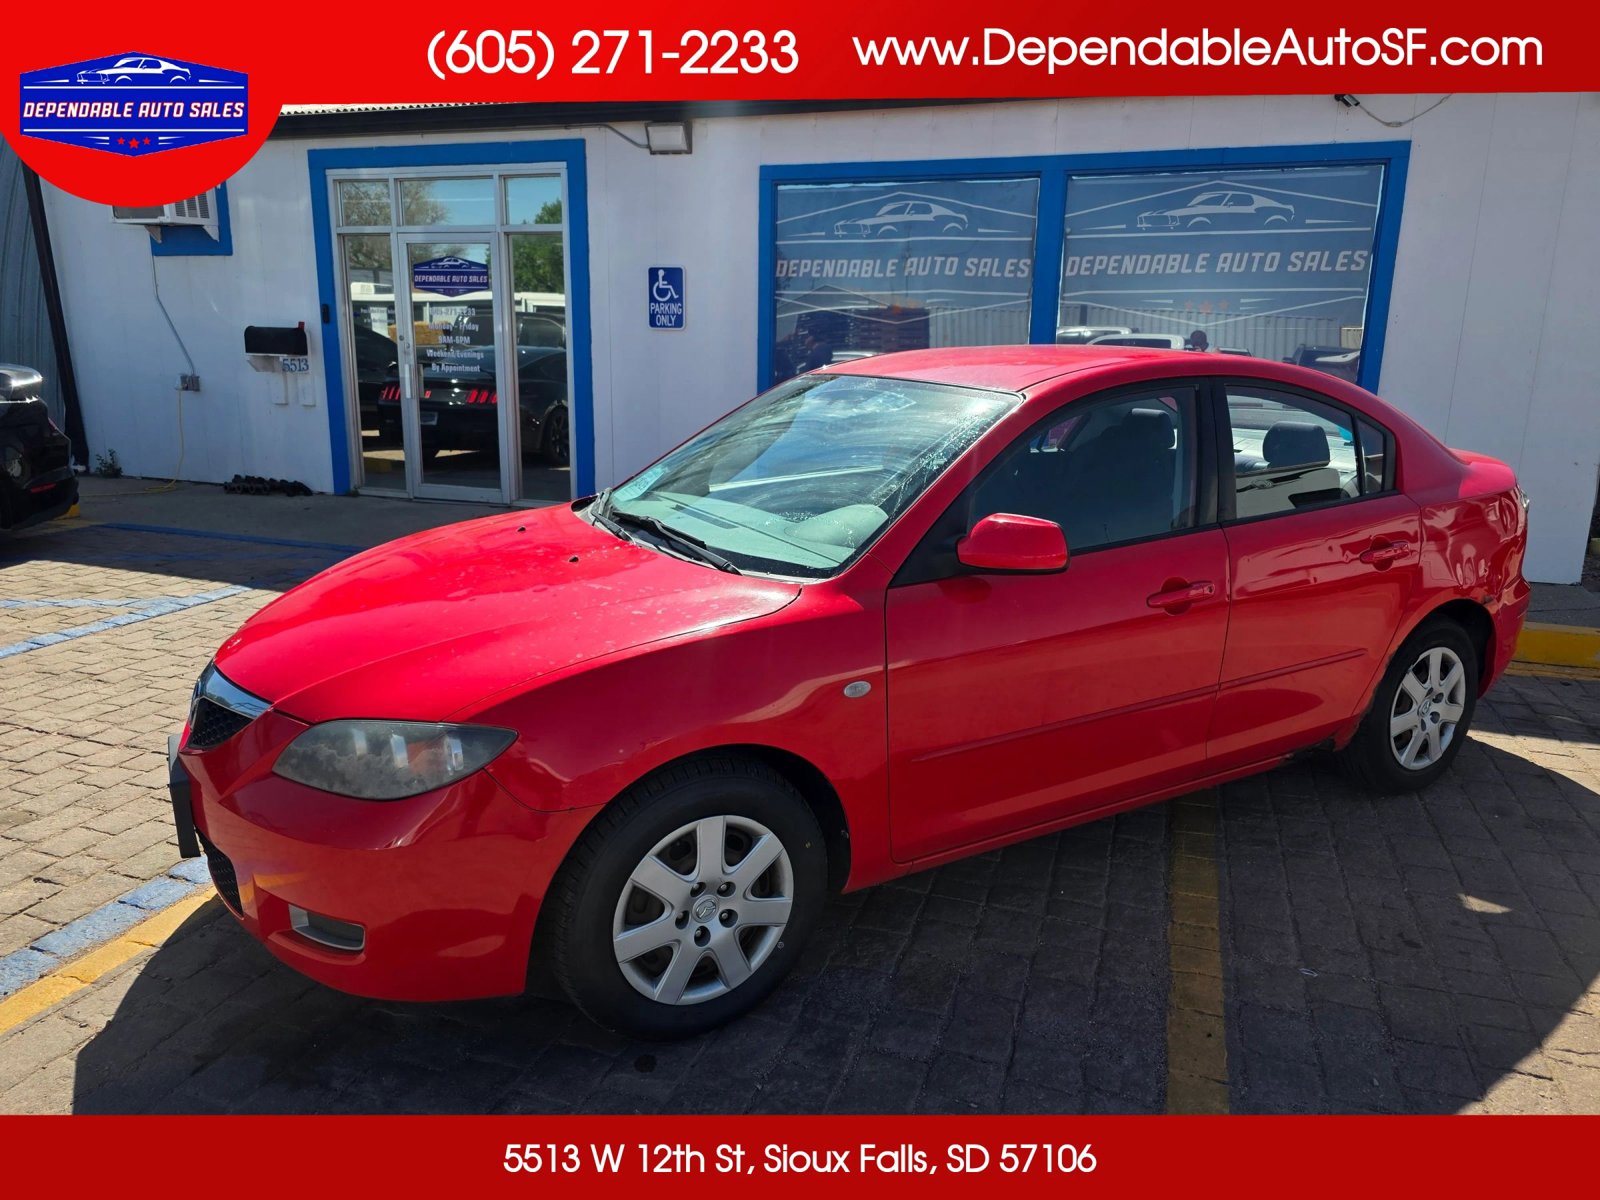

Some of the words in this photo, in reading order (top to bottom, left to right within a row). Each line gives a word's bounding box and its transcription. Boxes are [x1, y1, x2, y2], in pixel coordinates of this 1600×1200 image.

[775, 259, 899, 278] DEPENDABLE
[904, 256, 959, 276] AUTO
[964, 258, 1032, 278] SALES
[1065, 253, 1210, 277] DEPENDABLE
[1216, 251, 1280, 273] AUTO
[1287, 250, 1368, 272] SALES
[414, 275, 451, 283] DEPENDABLE
[451, 275, 469, 283] AUTO
[468, 275, 488, 283] SALES
[650, 303, 682, 315] PARKING
[655, 314, 677, 326] ONLY
[459, 322, 479, 332] Friday
[438, 335, 471, 344] 9AM-6PM
[282, 358, 309, 372] 5513
[432, 363, 440, 373] By
[441, 363, 480, 373] Appointment
